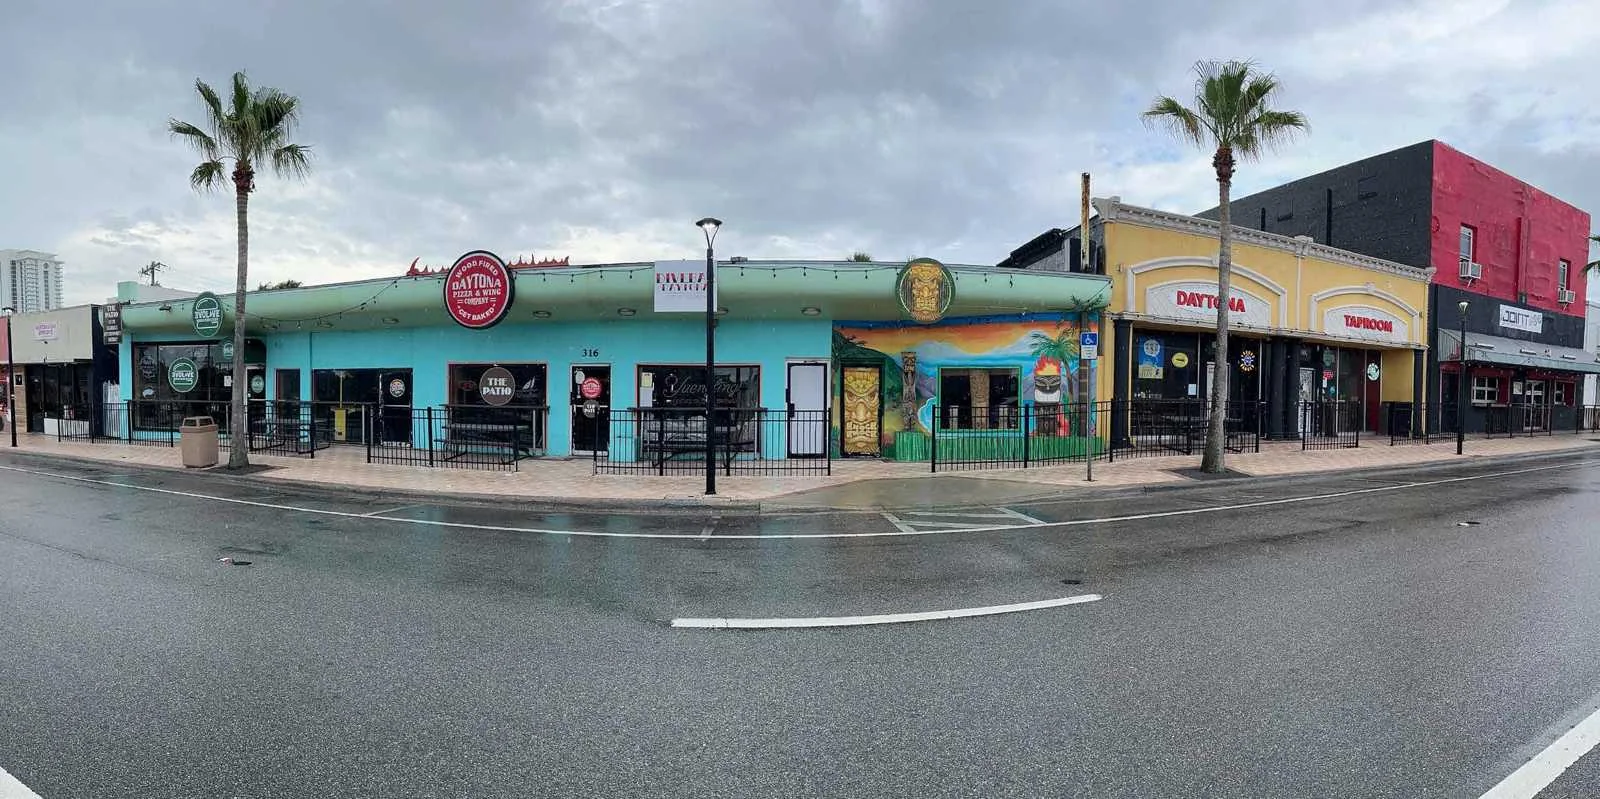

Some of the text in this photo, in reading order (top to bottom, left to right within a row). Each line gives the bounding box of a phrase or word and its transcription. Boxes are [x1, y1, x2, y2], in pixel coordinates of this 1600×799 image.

[455, 260, 499, 279] WOOD FIRED
[452, 273, 503, 291] DAYTONA
[453, 290, 473, 299] PIZZA
[483, 288, 502, 296] WING
[464, 297, 489, 306] COMPANY
[1176, 290, 1246, 313] DAYTONA
[458, 306, 496, 321] GET BAKED
[1344, 315, 1393, 333] TAPROOM
[582, 349, 599, 358] 316
[488, 377, 509, 387] THE
[482, 386, 512, 396] PATIO
